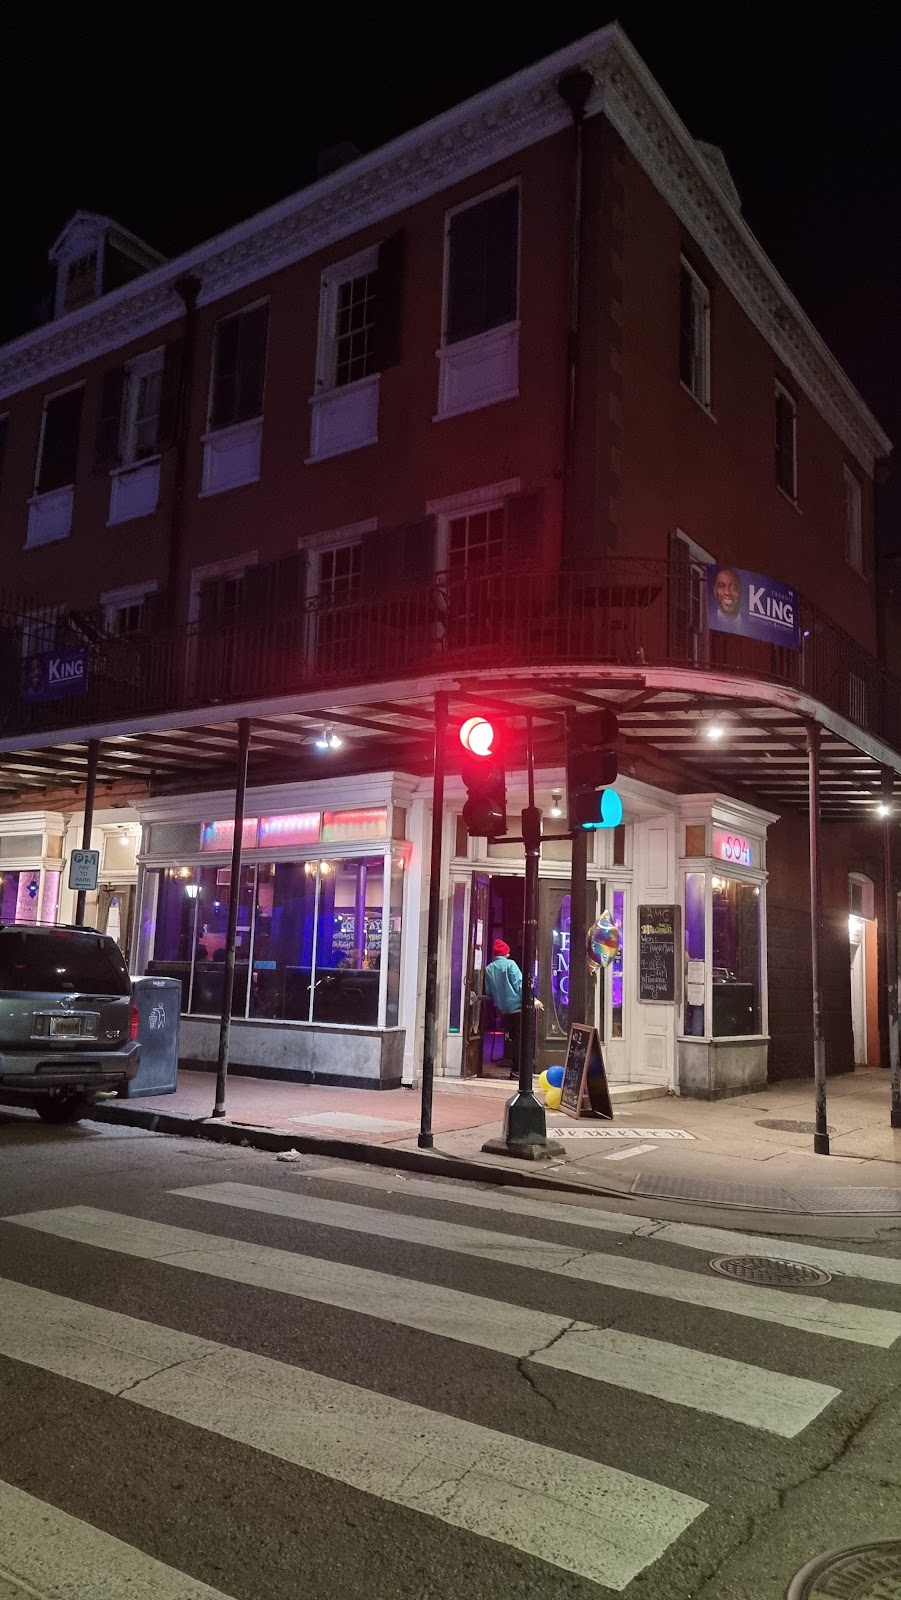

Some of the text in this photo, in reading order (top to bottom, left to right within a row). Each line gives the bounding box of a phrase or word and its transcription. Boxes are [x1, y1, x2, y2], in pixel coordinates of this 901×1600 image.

[749, 584, 794, 624] KING
[48, 659, 83, 680] KING
[725, 836, 748, 862] 504
